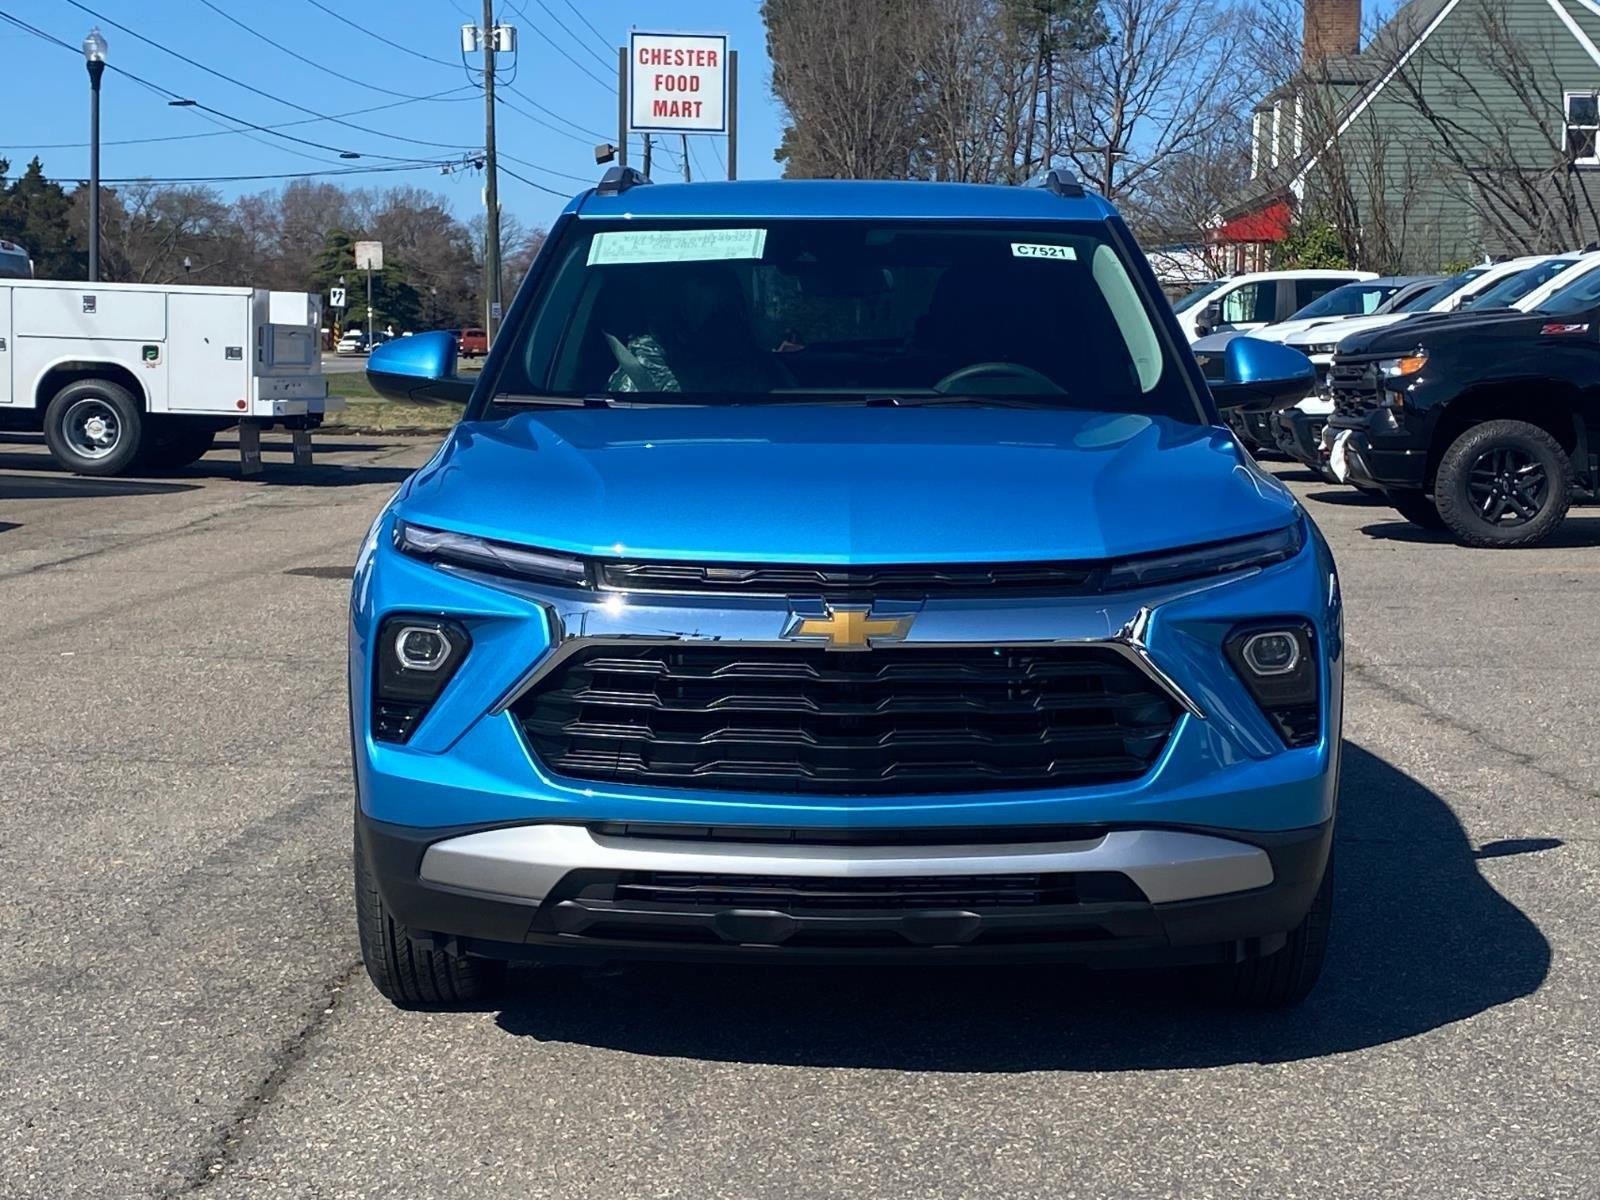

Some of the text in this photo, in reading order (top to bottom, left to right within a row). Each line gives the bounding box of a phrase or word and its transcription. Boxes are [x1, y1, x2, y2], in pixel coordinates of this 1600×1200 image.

[639, 47, 718, 67] CHESTER
[654, 74, 700, 93] FOOD
[653, 100, 703, 118] MART
[1017, 245, 1066, 257] C7521
